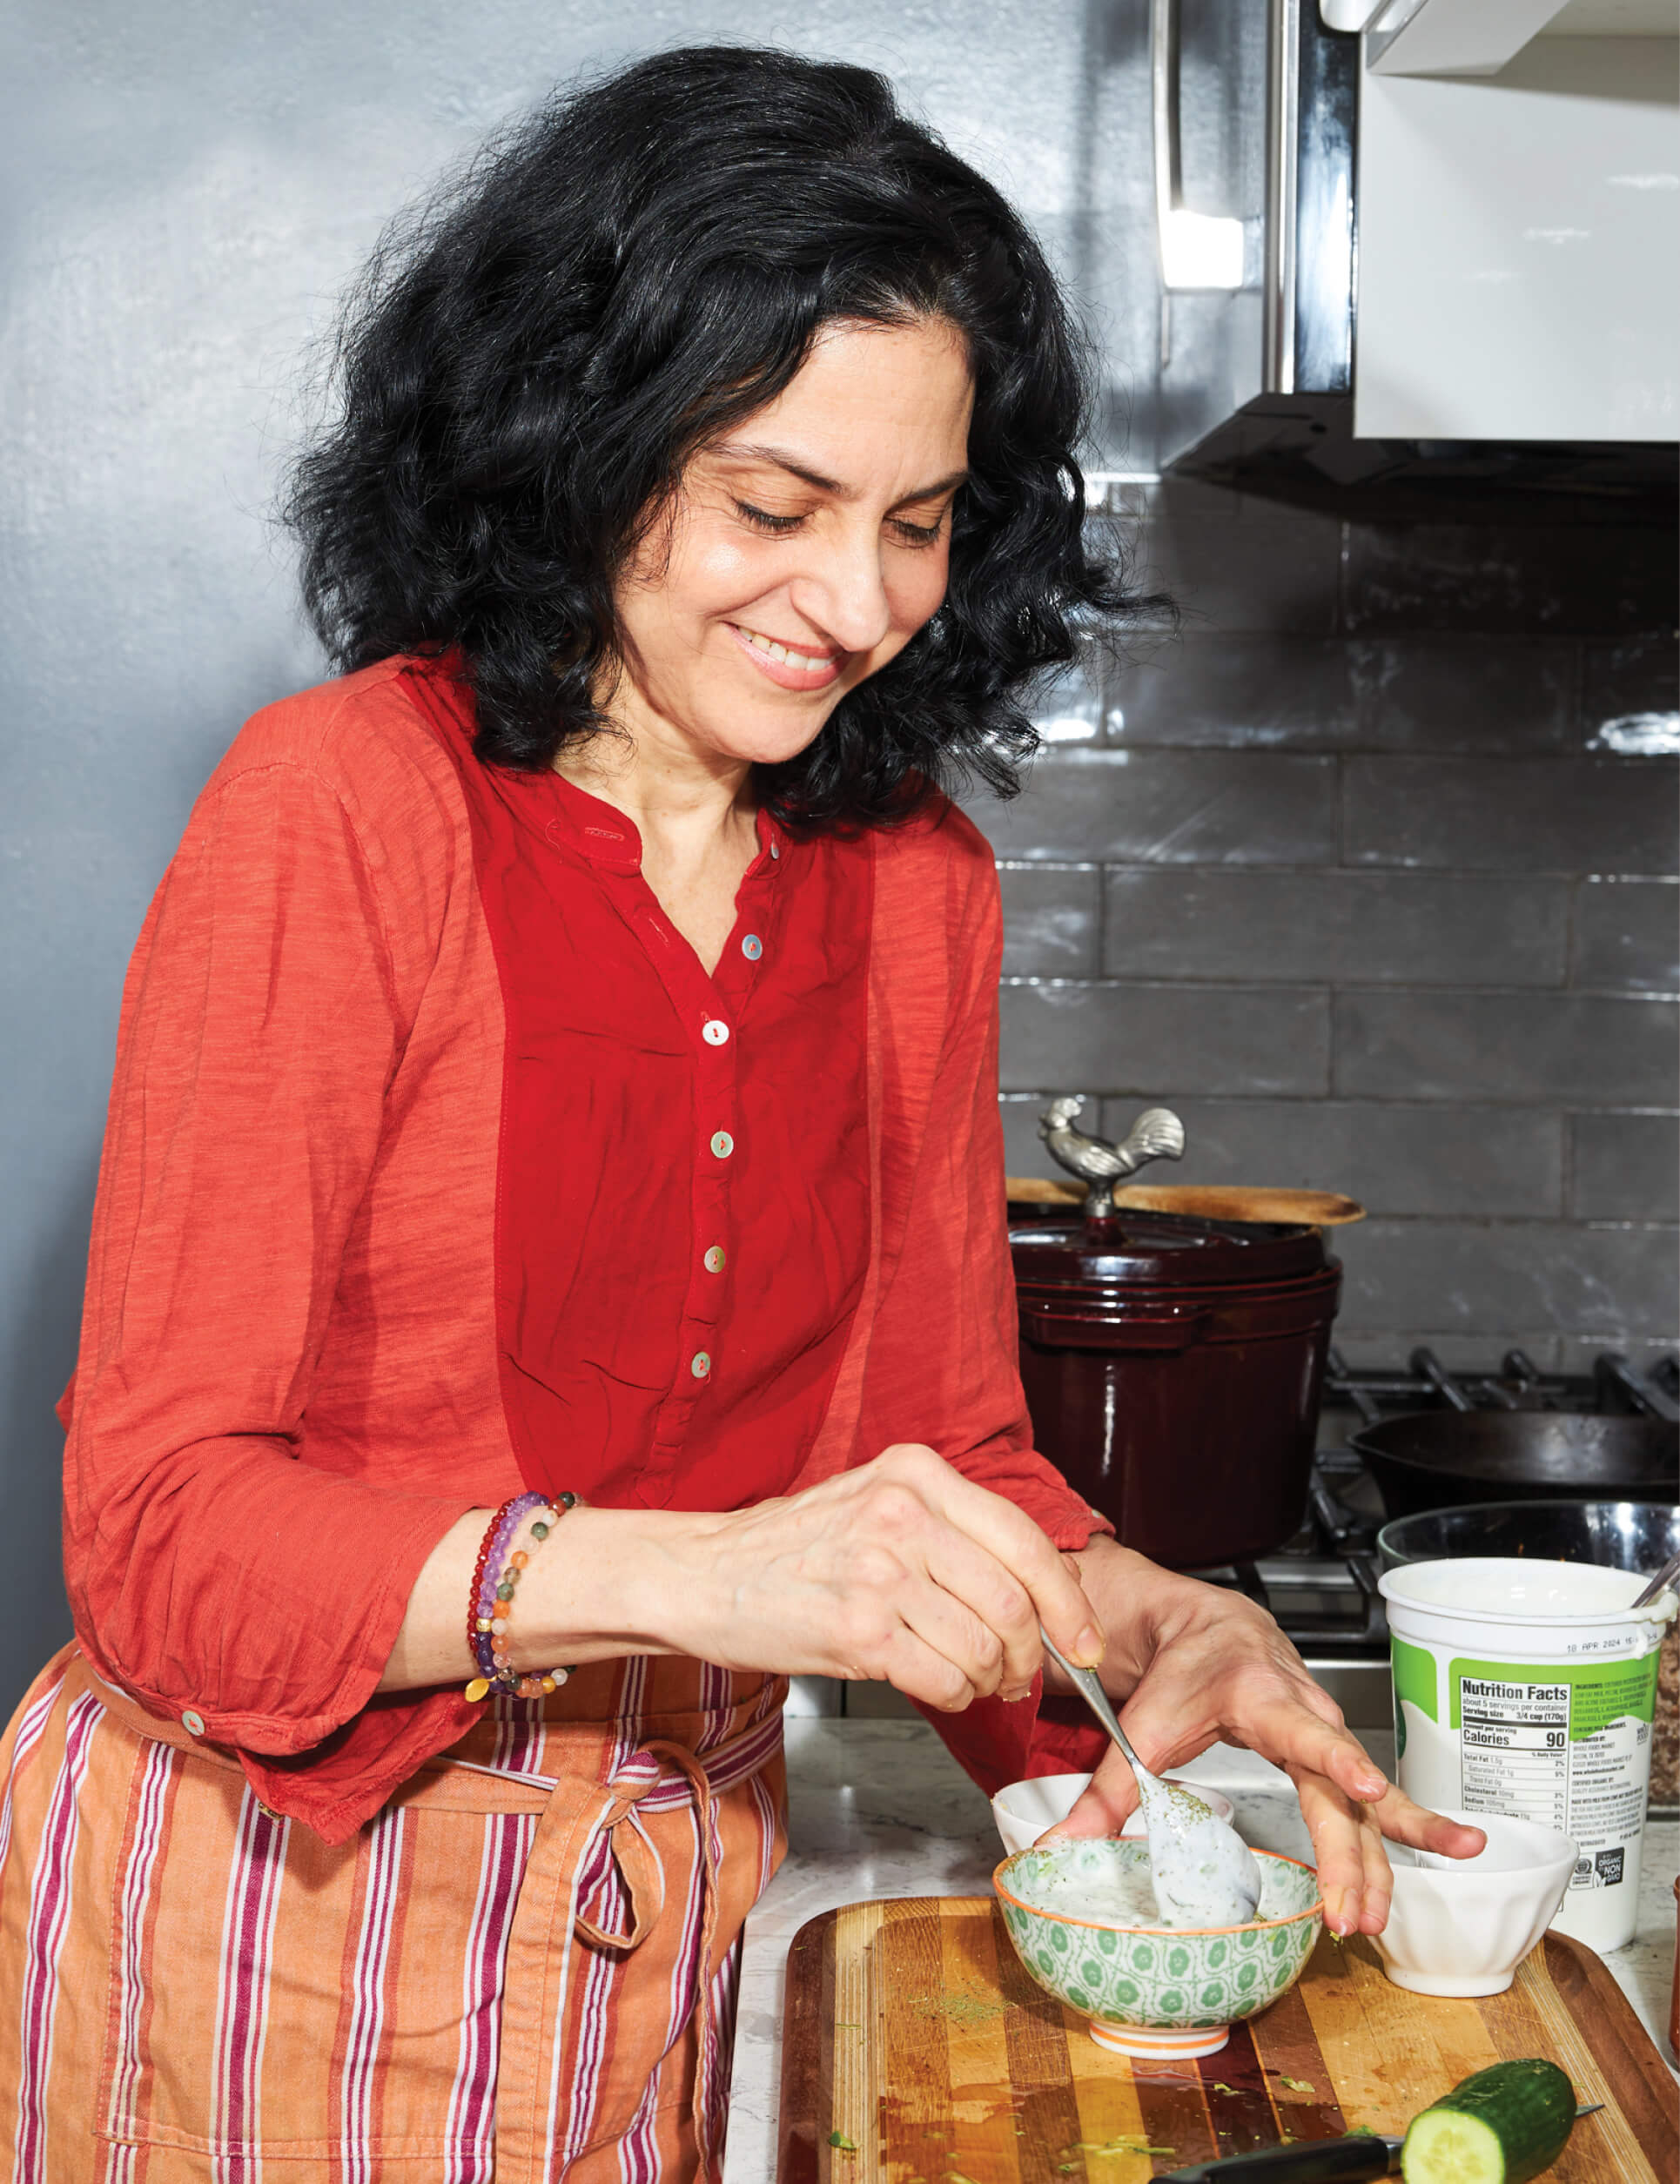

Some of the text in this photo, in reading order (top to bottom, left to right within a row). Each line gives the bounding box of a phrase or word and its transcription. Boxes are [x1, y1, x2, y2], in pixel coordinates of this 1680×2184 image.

[1582, 1642, 1598, 1650] APR
[1462, 1679, 1522, 1699] Nutrition
[1528, 1686, 1567, 1700] Facts
[1462, 1697, 1481, 1706] about
[1488, 1702, 1520, 1711] servings
[1462, 1706, 1488, 1717] Serving
[1489, 1709, 1504, 1717] size
[1544, 1712, 1567, 1721] (170g)
[1463, 1729, 1509, 1745] Calories
[1546, 1732, 1565, 1747] 90
[1468, 1764, 1495, 1774] Saturated
[1464, 1785, 1497, 1795] Cholesterol
[1464, 1796, 1484, 1804] Sodium
[1598, 1856, 1622, 1866] ORGANIC
[1603, 1864, 1621, 1874] NON
